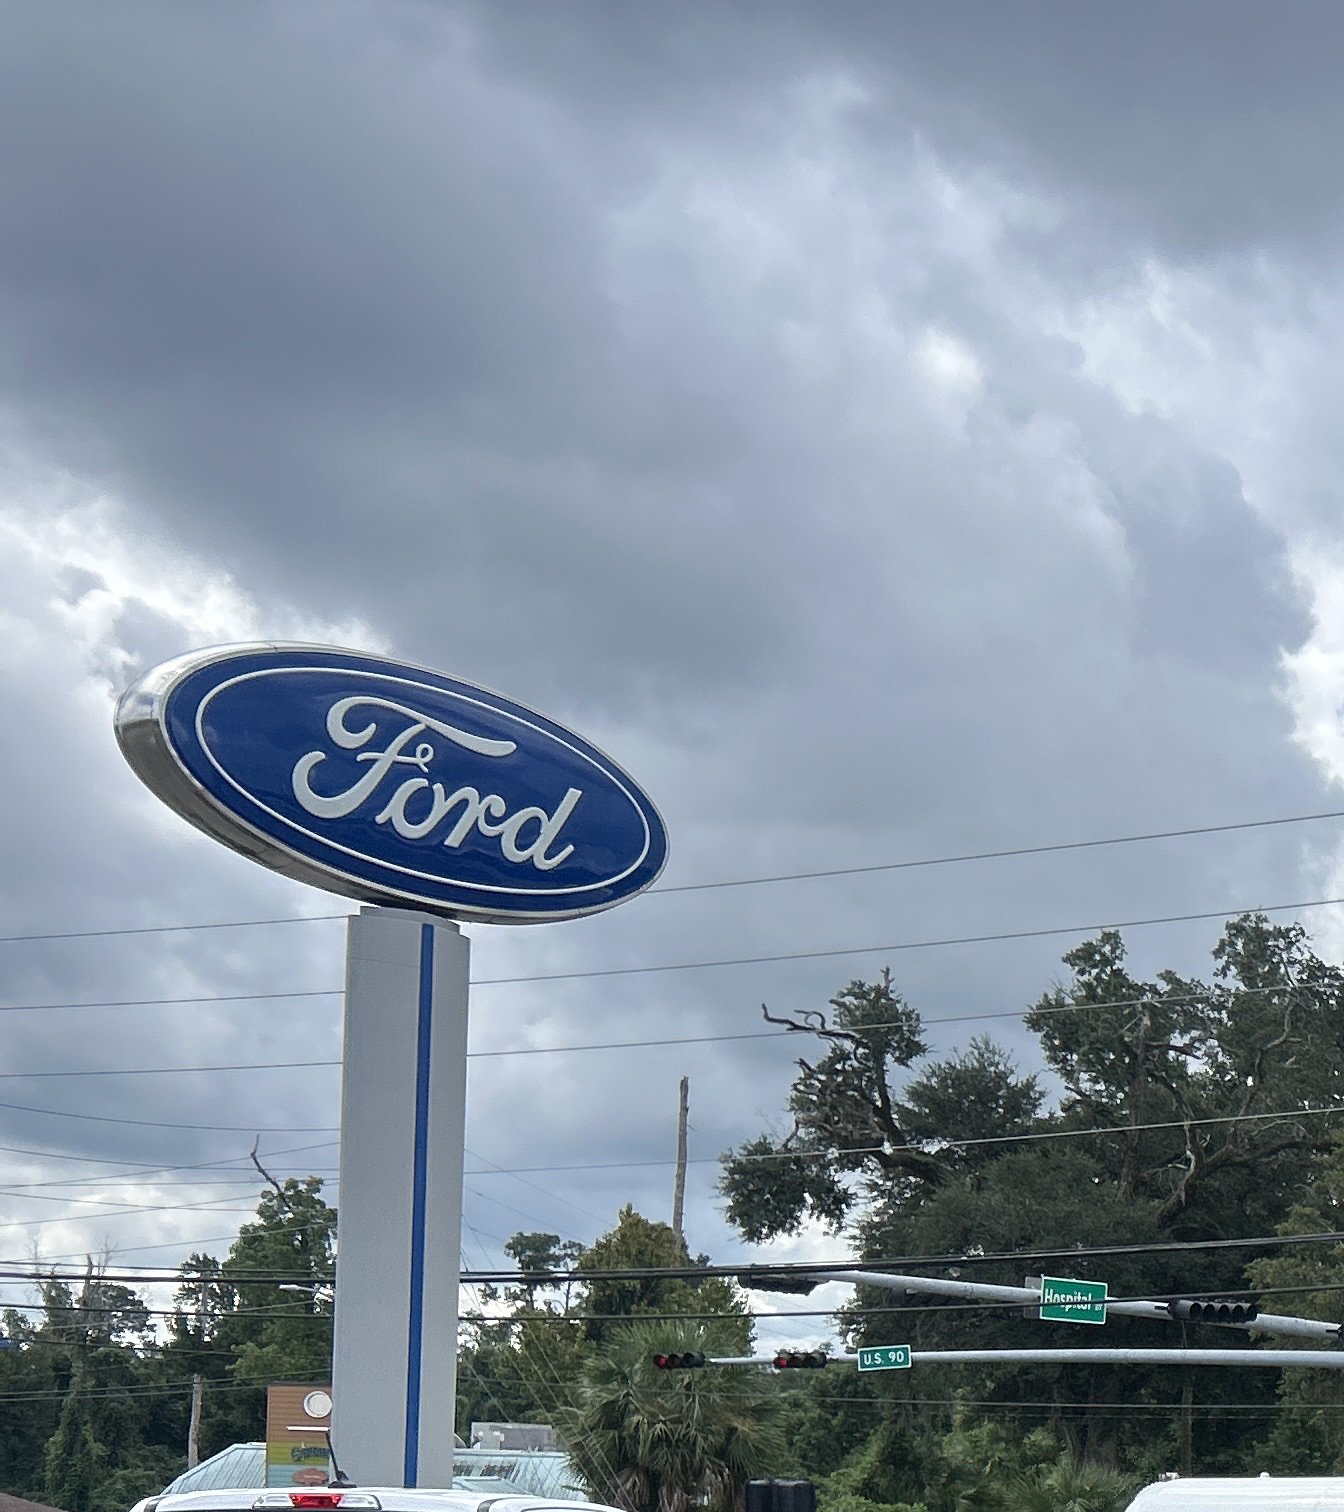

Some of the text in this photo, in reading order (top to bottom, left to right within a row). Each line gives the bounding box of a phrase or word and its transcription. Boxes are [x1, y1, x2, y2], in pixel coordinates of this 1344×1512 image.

[291, 695, 583, 871] Ford
[1044, 1288, 1092, 1312] Hospital
[863, 1351, 905, 1366] U.S. 90
